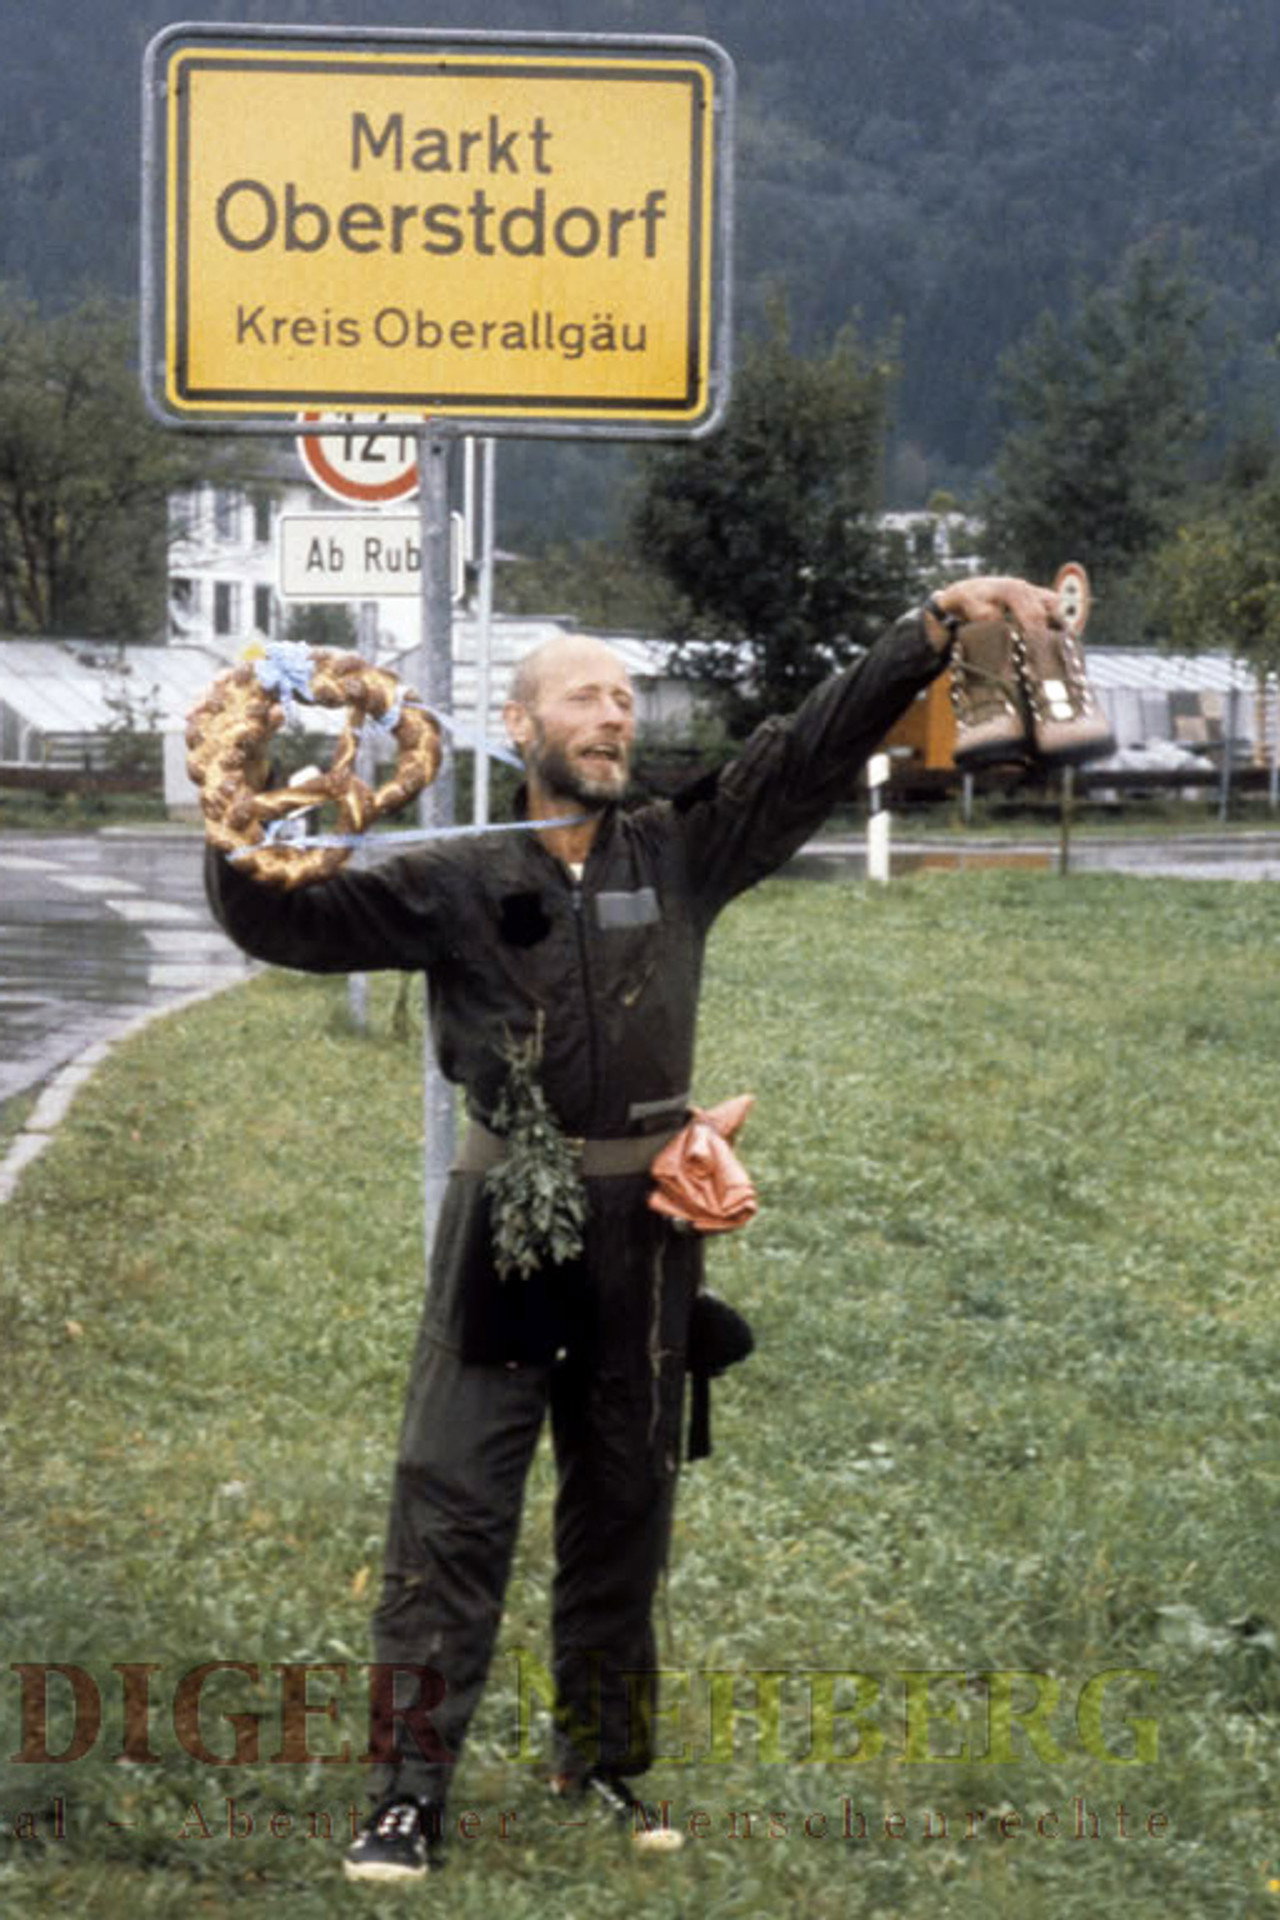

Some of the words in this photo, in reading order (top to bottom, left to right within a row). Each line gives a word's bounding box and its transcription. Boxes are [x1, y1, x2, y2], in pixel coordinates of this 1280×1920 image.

[350, 111, 553, 175] Markt
[215, 178, 668, 259] Oberstdorf
[235, 305, 362, 348] Kreis
[373, 306, 649, 360] Oberallgäu
[305, 536, 345, 574] Ab
